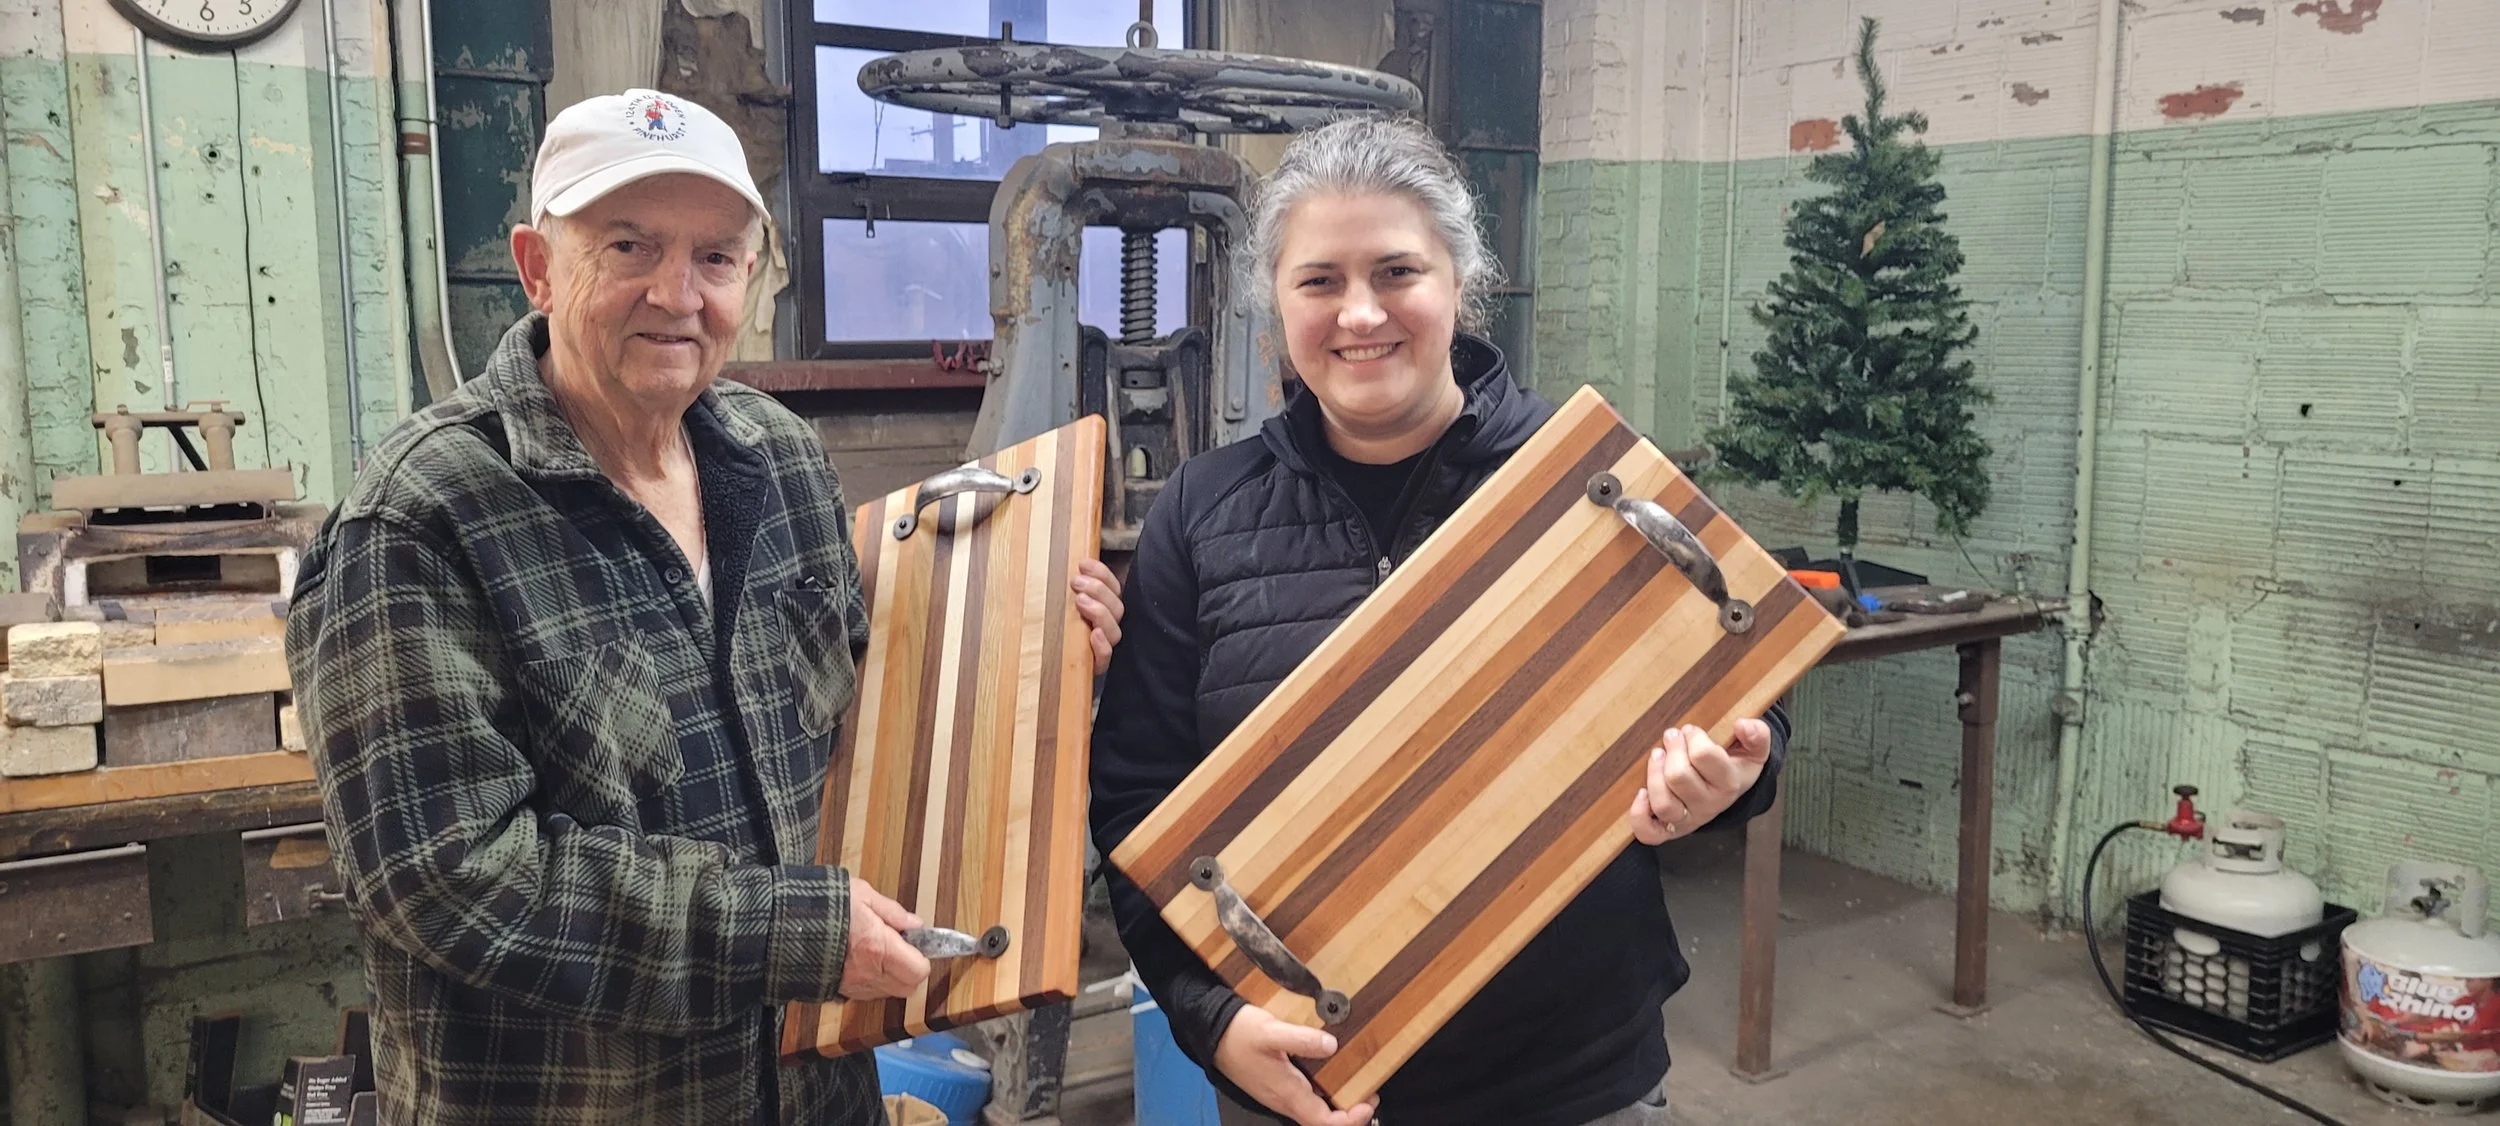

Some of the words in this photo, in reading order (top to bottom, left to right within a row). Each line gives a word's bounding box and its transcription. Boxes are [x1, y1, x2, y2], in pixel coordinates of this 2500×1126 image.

[199, 0, 215, 21] 6
[237, 0, 252, 15] 5
[632, 127, 687, 142] PINEHURST
[2387, 971, 2460, 1004] Blue
[2379, 991, 2476, 1021] Rhino
